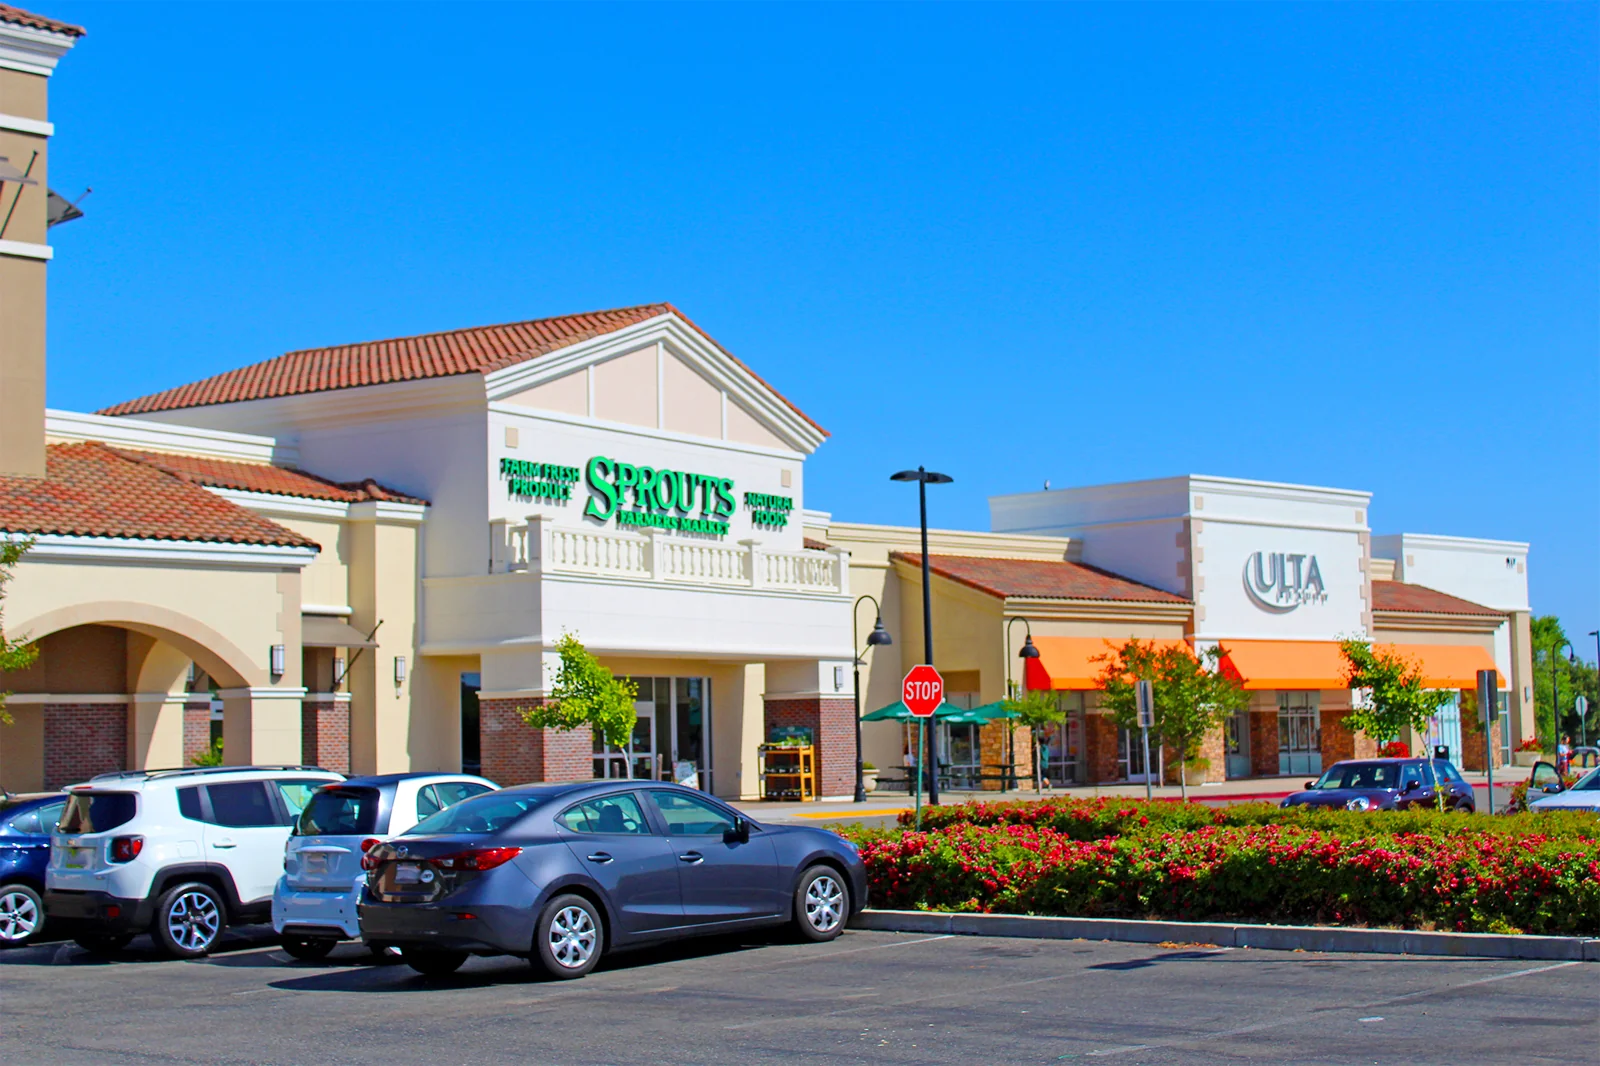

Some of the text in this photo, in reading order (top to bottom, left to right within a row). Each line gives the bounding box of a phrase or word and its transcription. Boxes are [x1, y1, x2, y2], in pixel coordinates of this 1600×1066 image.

[502, 458, 580, 482] FARM FRESH
[510, 479, 573, 500] PRODUCE
[585, 456, 736, 519] SPROUTS
[617, 510, 730, 535] FARMERS MARKET
[753, 510, 788, 526] FOODS
[1253, 551, 1324, 593] ULTA
[905, 681, 940, 700] STOP
